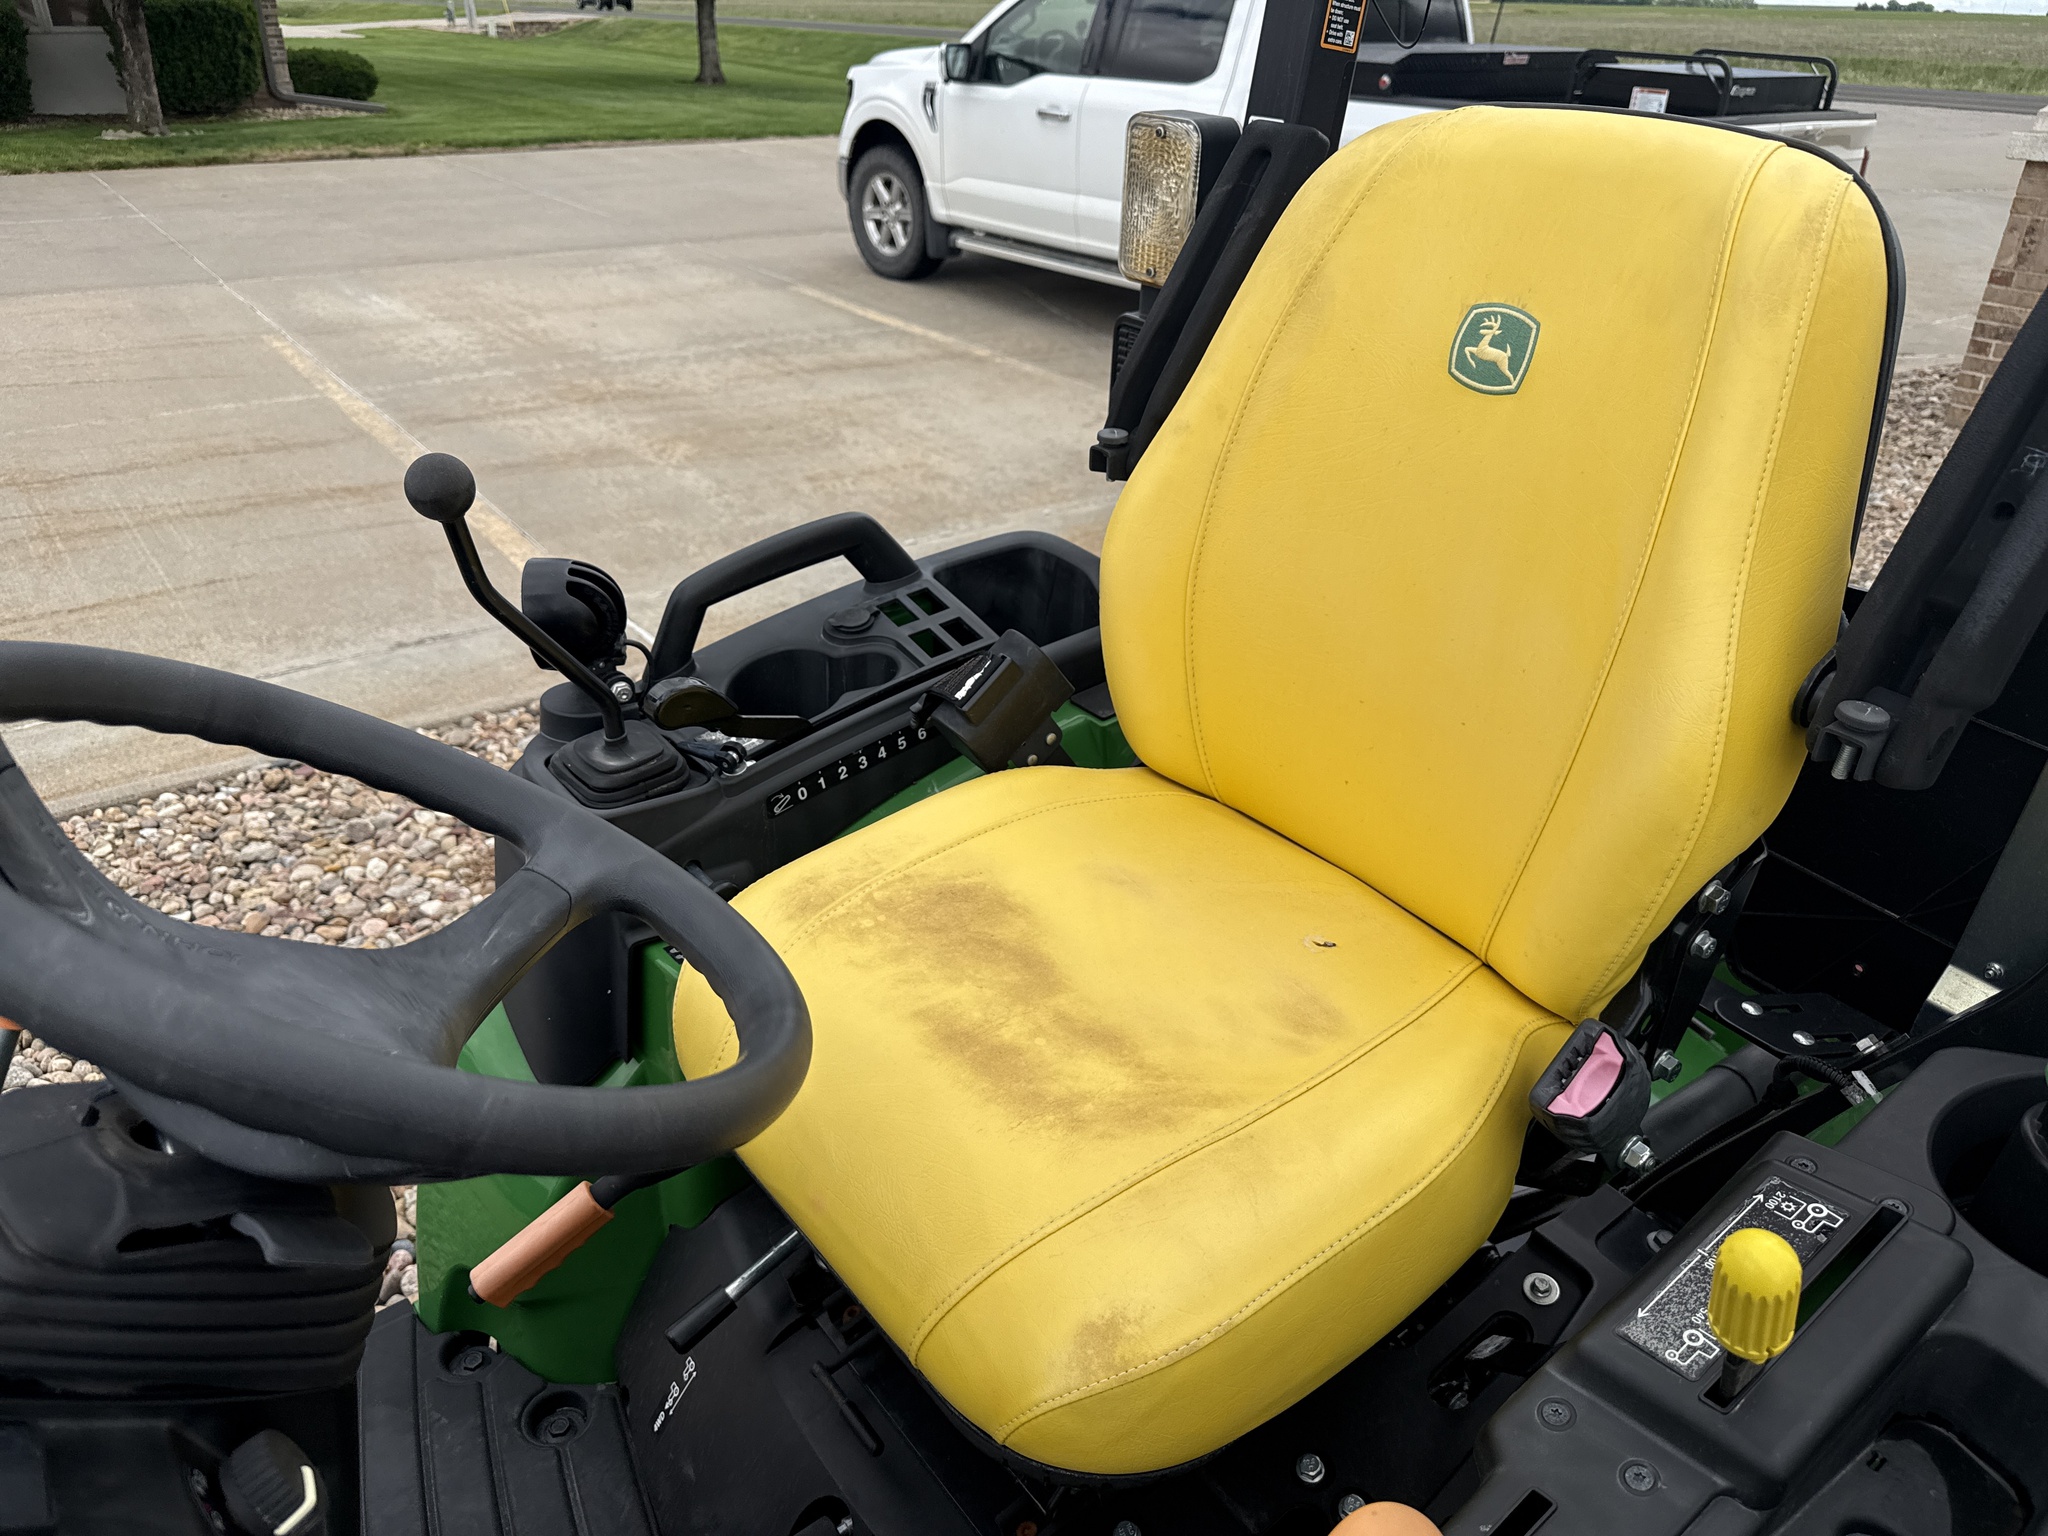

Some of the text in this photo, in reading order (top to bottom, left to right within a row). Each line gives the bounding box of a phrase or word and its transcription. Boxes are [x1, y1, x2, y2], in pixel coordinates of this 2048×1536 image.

[797, 728, 927, 801] 0 1 2 3 4 5 6
[1764, 1190, 1786, 1210] 2100
[654, 1410, 665, 1432] 4WD
